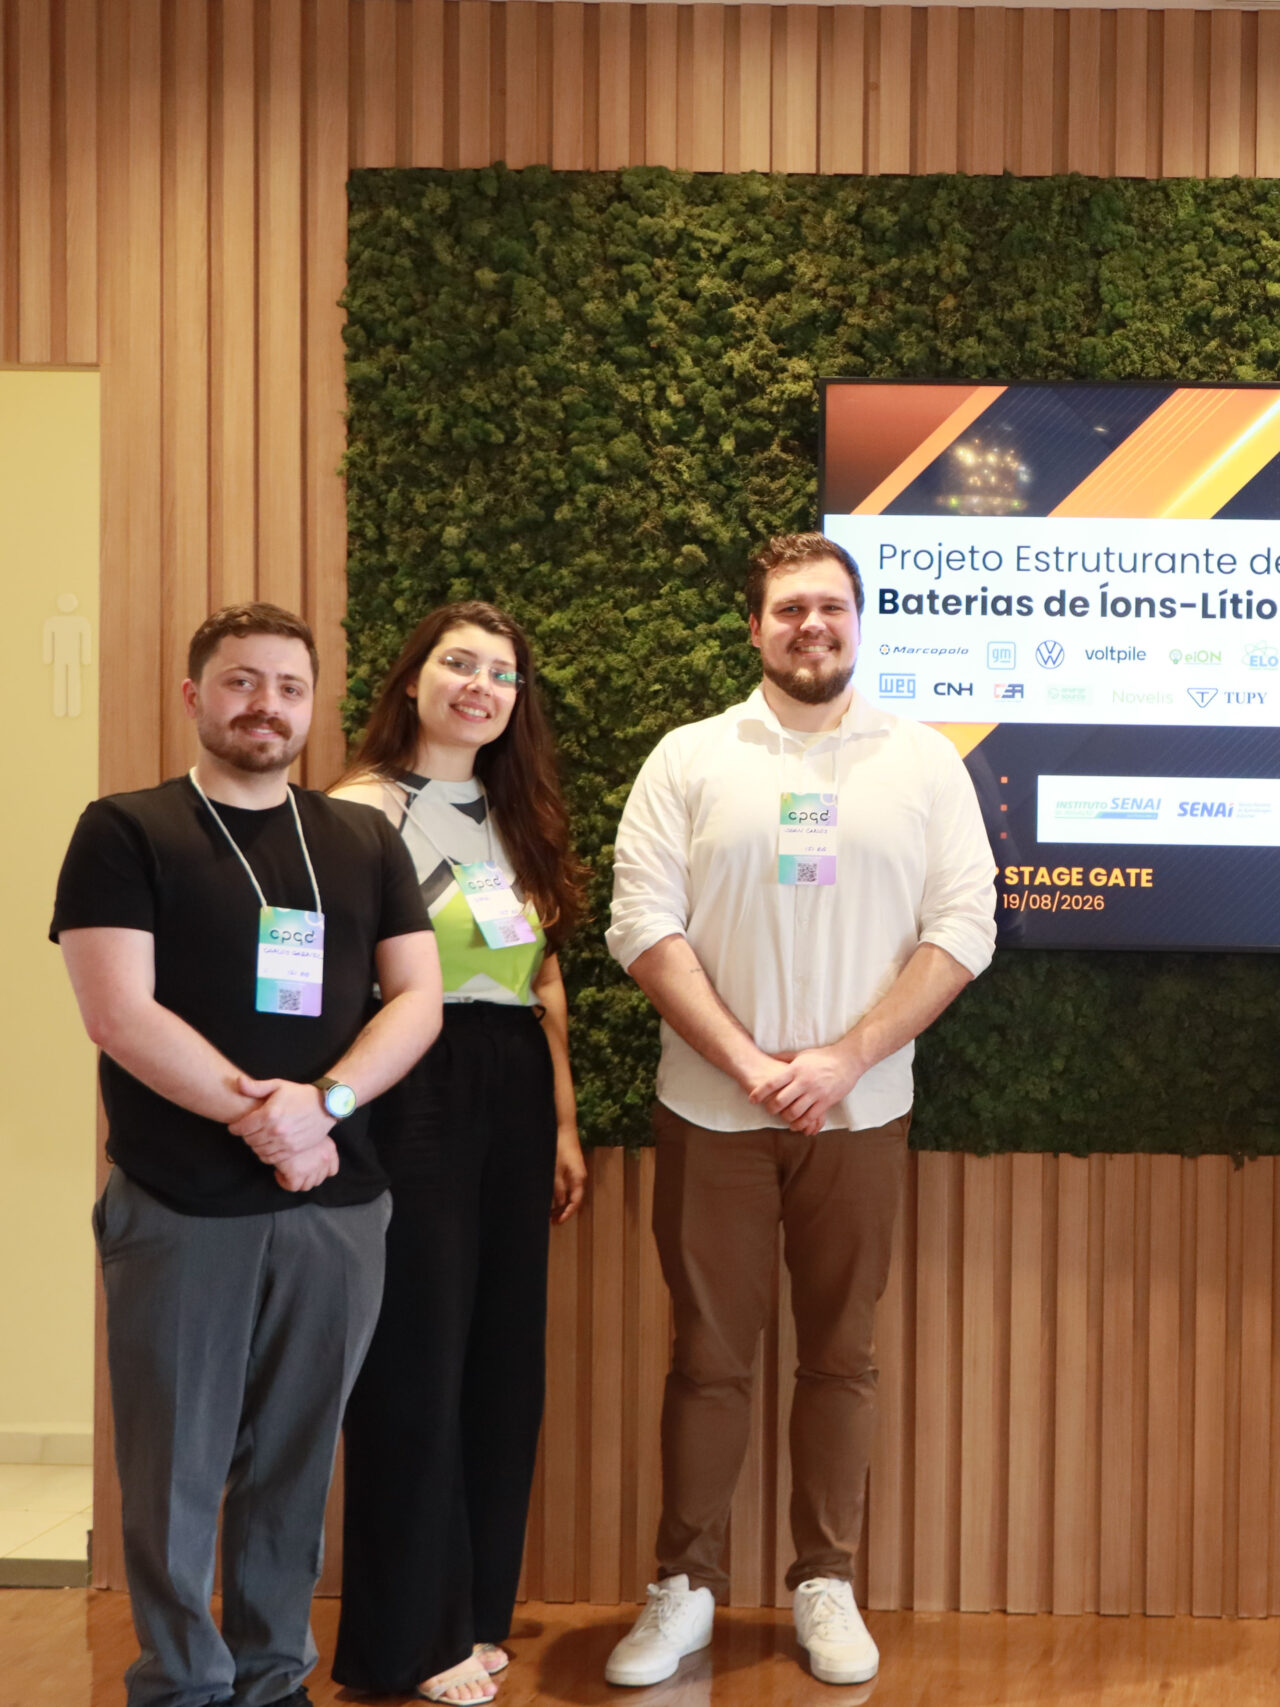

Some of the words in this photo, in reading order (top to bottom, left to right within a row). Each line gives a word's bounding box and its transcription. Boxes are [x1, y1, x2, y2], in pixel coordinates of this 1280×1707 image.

[879, 542, 1003, 581] Projeto
[1016, 545, 1238, 577] Estruturante
[878, 586, 1034, 617] Baterias
[1044, 589, 1090, 617] de
[1099, 581, 1279, 621] Íons-Lítio
[893, 645, 969, 656] Marcopolo
[1085, 645, 1147, 664] voltpile
[1250, 655, 1279, 667] ELO
[933, 682, 973, 697] CNH
[1112, 689, 1173, 705] Novelis
[1224, 691, 1267, 705] TUPY
[1055, 800, 1108, 810] INSTITUTO
[1110, 797, 1162, 811] SENAI
[1004, 866, 1083, 887] STAGE
[1089, 867, 1153, 888] GATE
[1002, 890, 1105, 913] 19/08/2026
